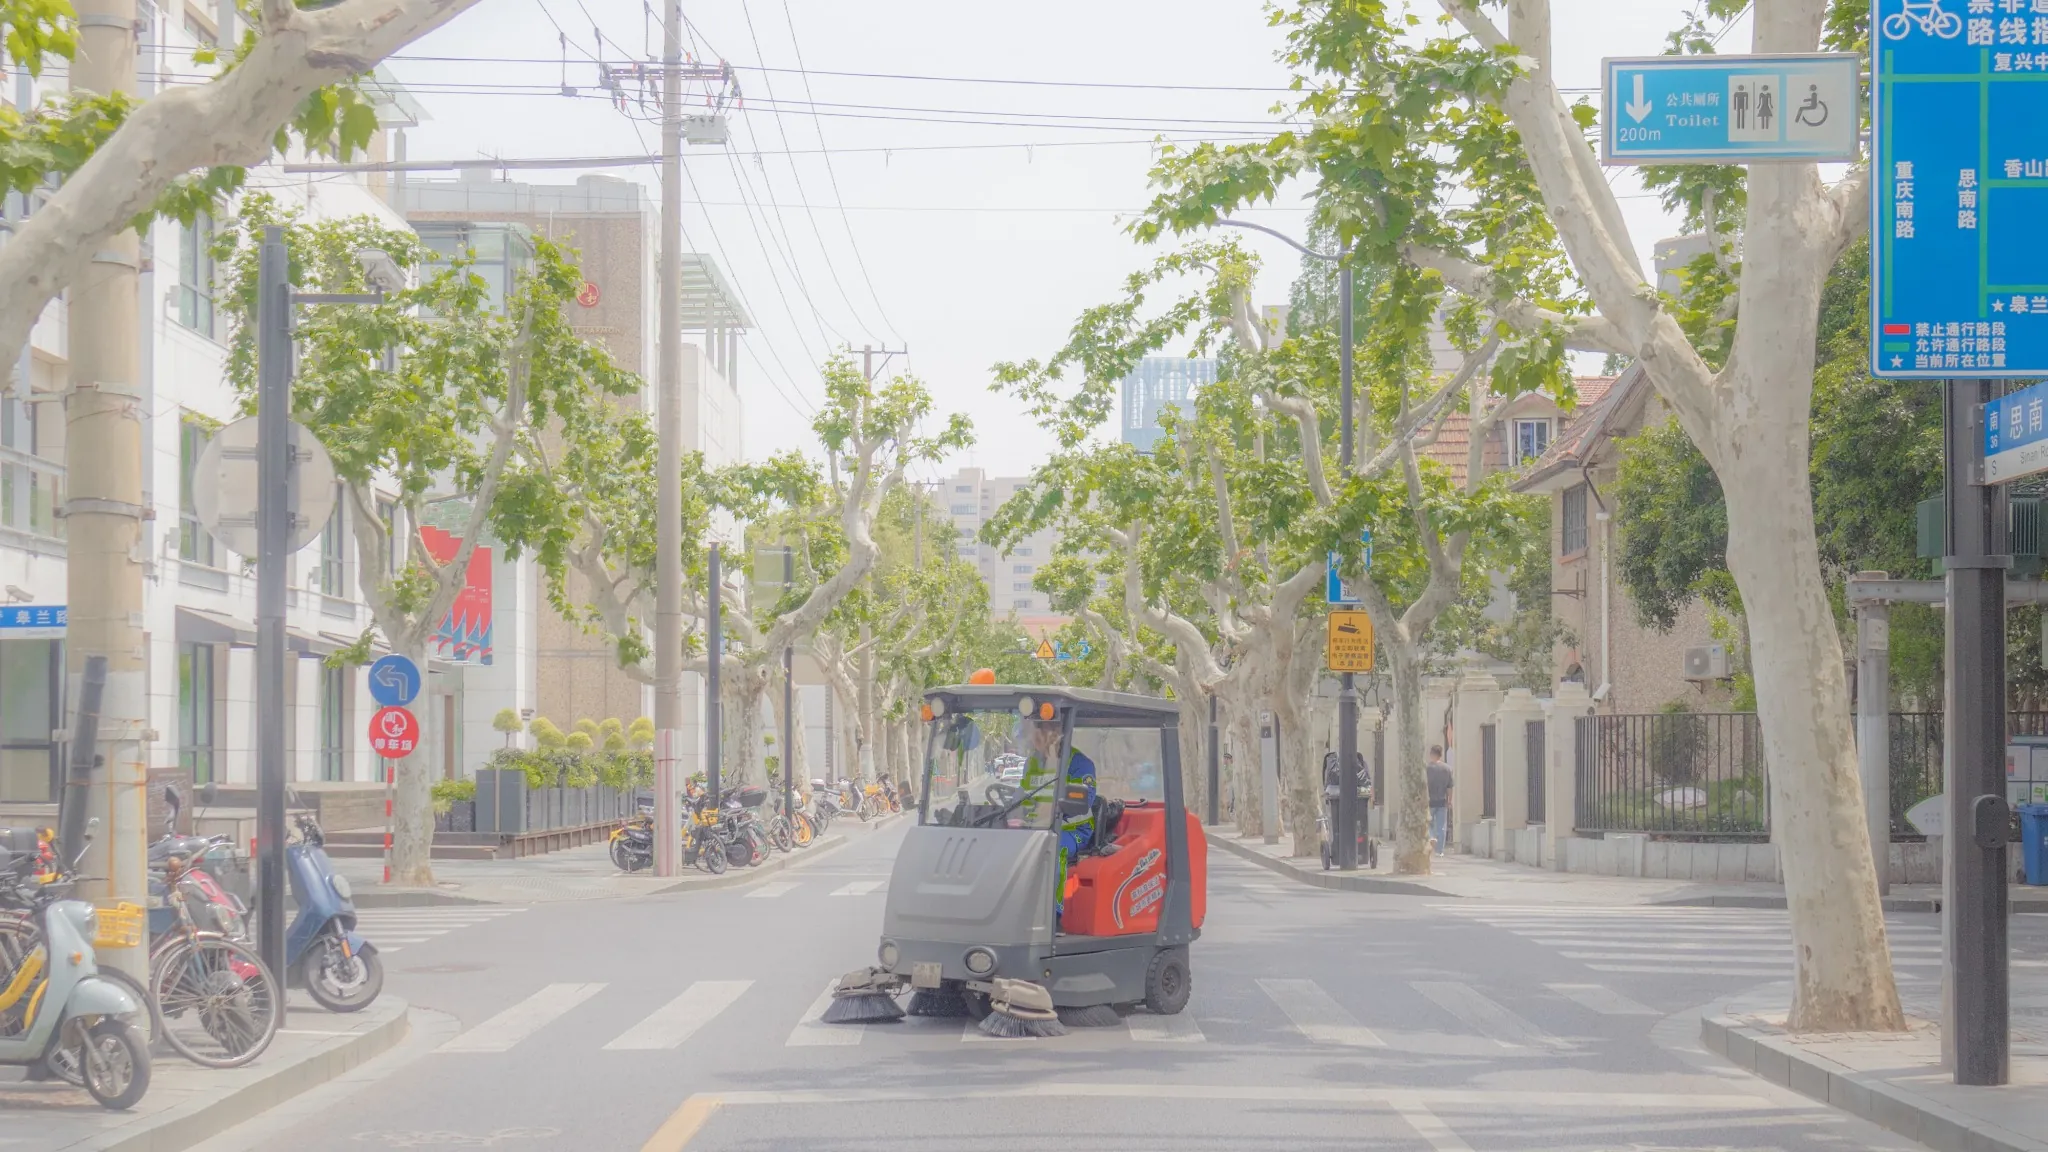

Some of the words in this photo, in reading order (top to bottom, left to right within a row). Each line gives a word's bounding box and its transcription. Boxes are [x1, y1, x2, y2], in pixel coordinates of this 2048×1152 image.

[1994, 52, 2048, 72] 复兴中
[1666, 92, 1720, 107] 公共厕所
[1666, 114, 1720, 127] Toilet
[1619, 127, 1661, 142] 200m
[2004, 159, 2048, 178] 香山
[1895, 161, 1914, 239] 重庆南路
[1957, 169, 1977, 229] 思南路
[1915, 322, 2006, 337] 禁止通行路段
[1915, 338, 2006, 352] 允许通行路段
[1915, 354, 2006, 368] 当前所在位置
[1990, 411, 1999, 432] 南
[2009, 398, 2044, 440] 思南
